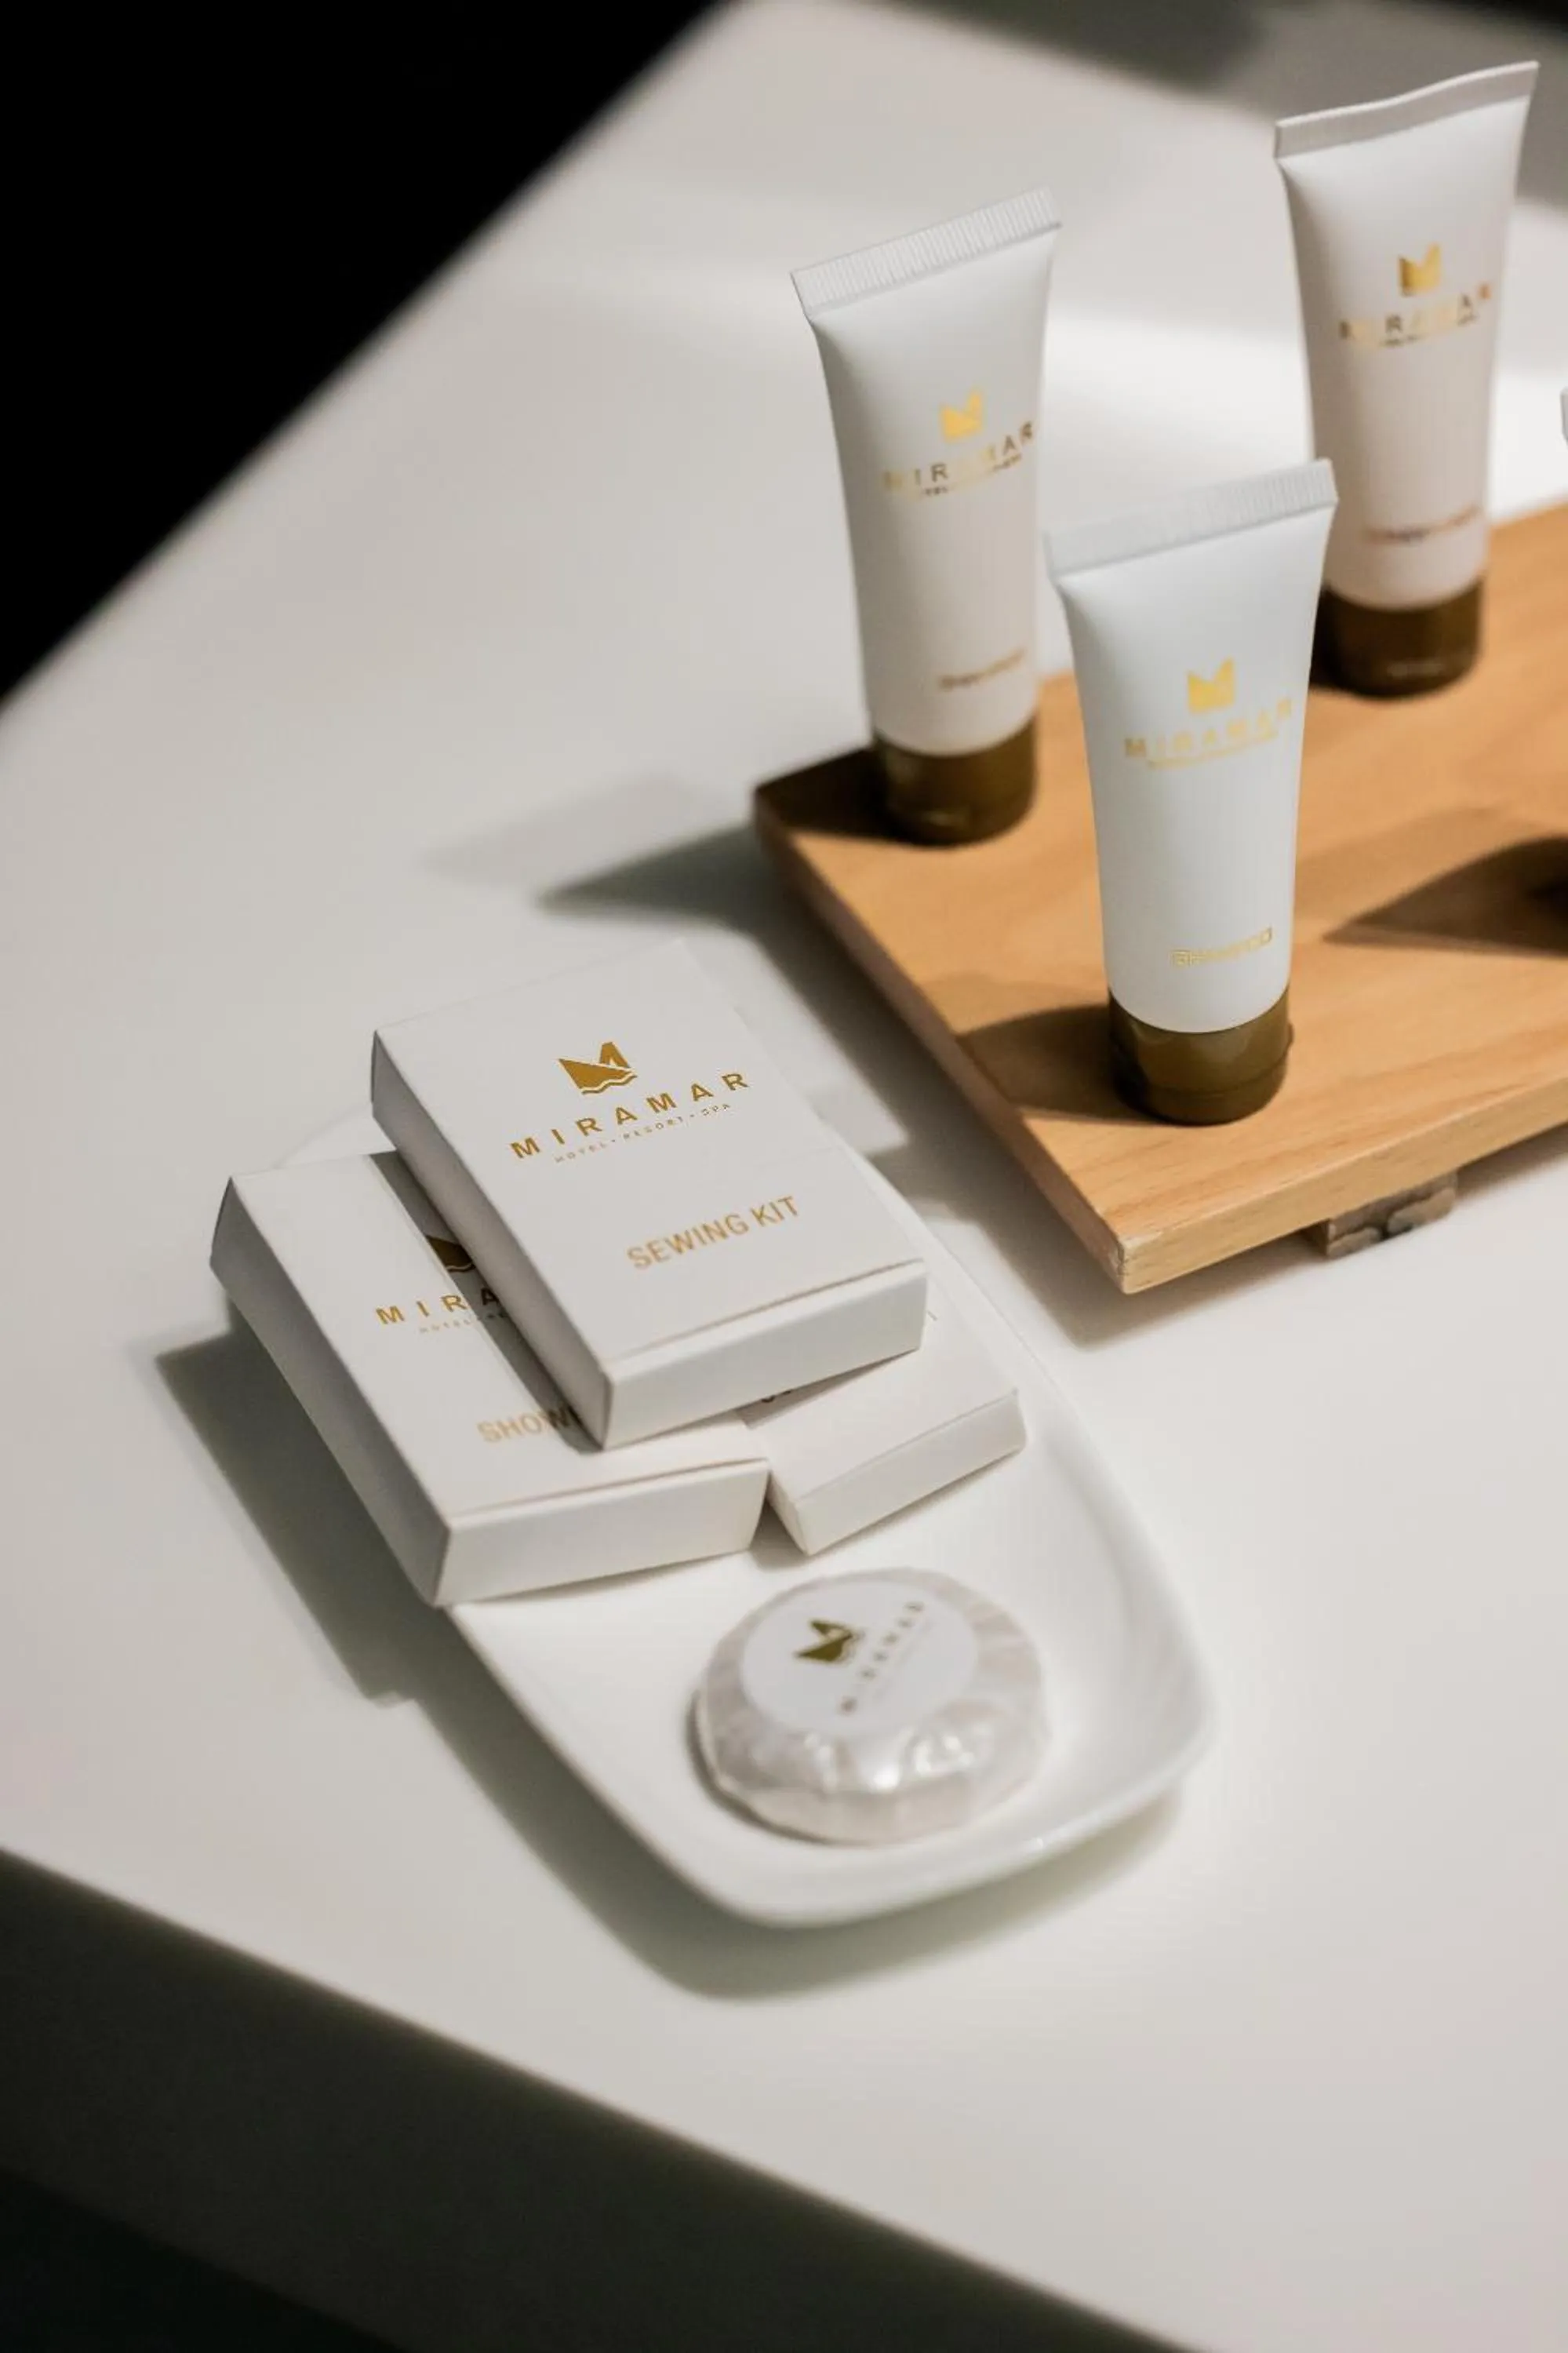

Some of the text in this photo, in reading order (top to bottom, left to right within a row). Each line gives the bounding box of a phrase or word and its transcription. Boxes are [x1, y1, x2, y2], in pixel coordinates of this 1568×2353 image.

[510, 1073, 749, 1159] MIRAMAR
[626, 1196, 801, 1270] SEWING KIT
[375, 1287, 501, 1324] MIRA
[476, 1406, 582, 1444] SHOW
